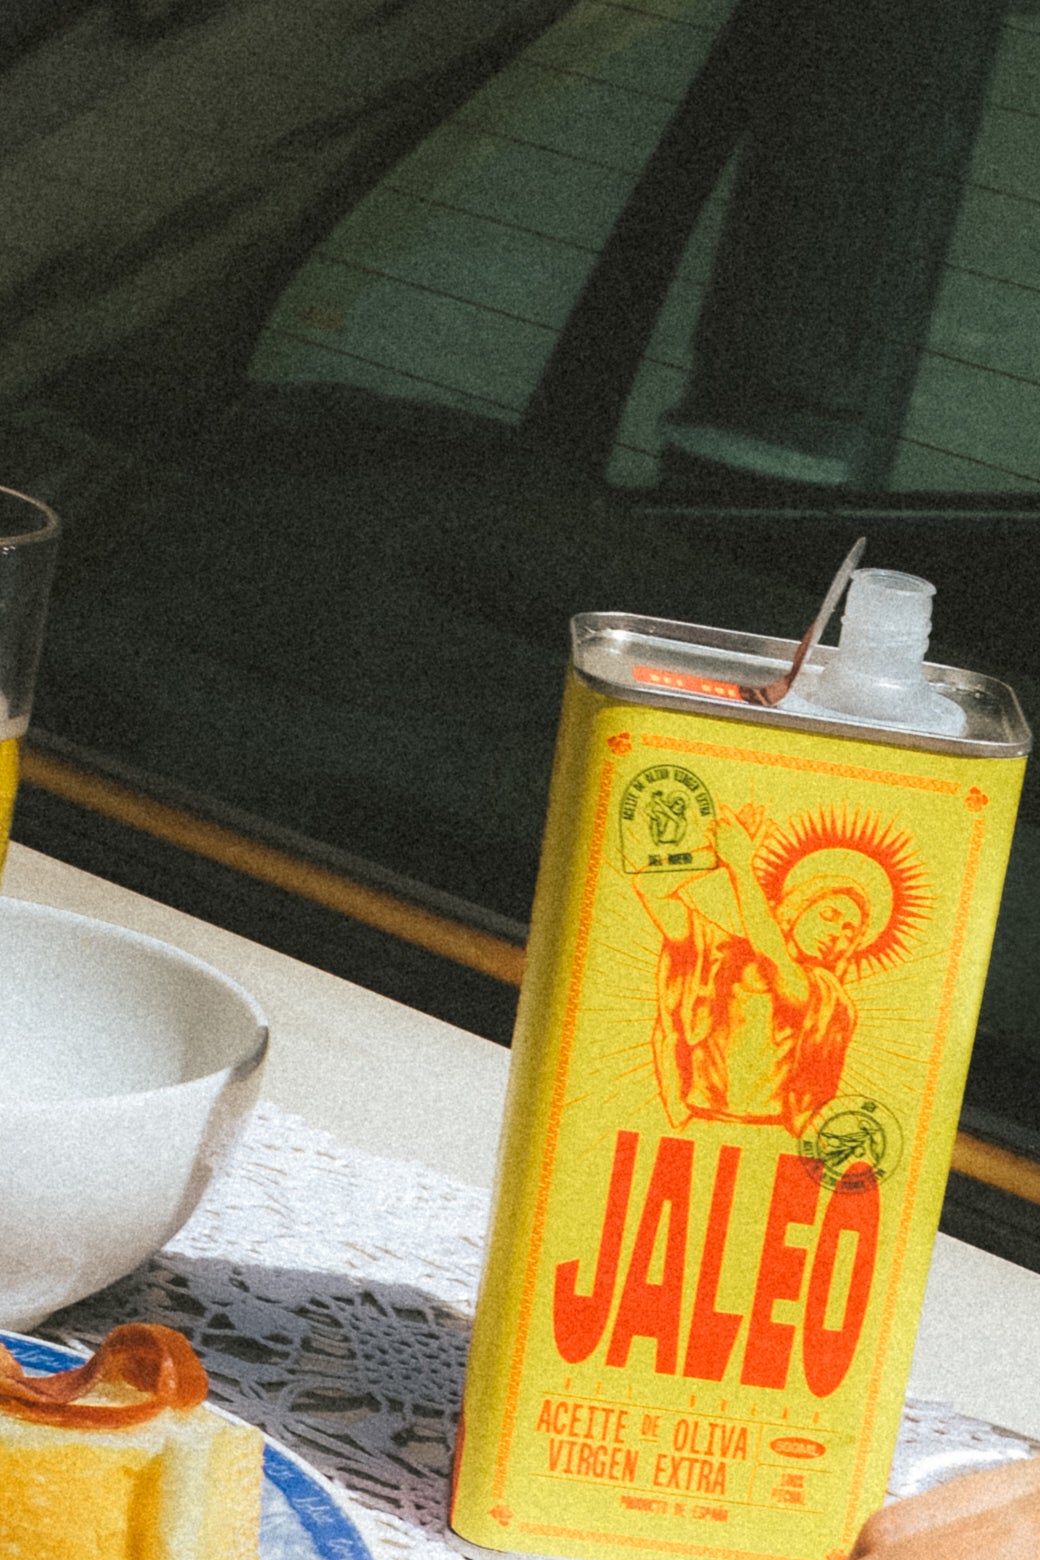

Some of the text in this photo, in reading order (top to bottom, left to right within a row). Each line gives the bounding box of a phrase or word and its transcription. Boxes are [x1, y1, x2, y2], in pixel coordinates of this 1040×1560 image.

[552, 1130, 880, 1400] JALEO
[536, 1398, 749, 1461] ACEITE DE OLIVA
[548, 1437, 728, 1496] VIRGEN EXTRA
